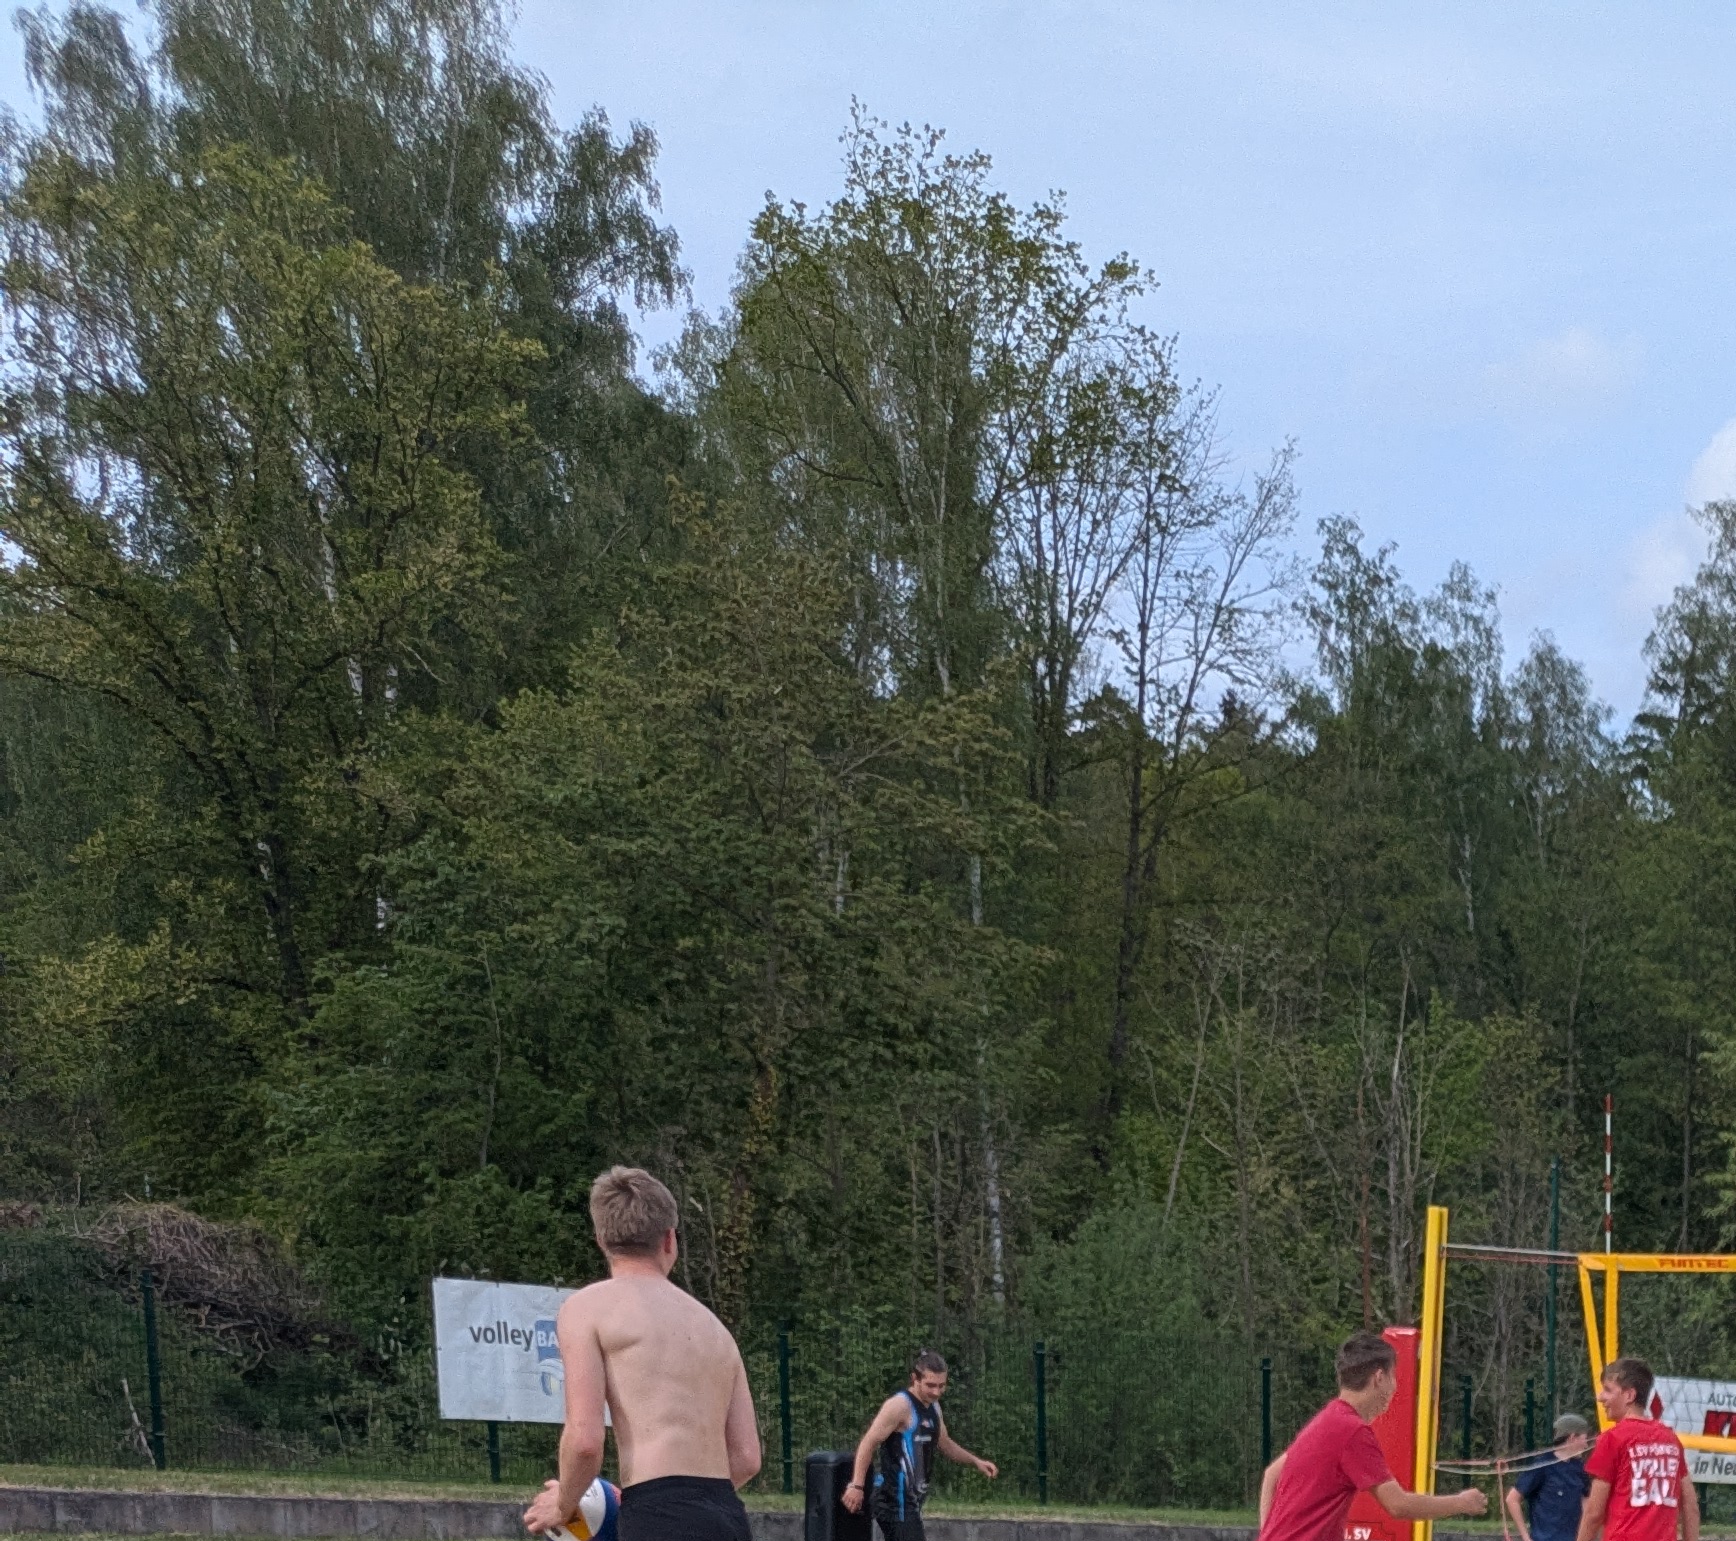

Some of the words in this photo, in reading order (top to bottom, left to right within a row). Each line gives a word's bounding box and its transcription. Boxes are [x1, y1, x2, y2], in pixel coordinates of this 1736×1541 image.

[469, 1320, 560, 1352] volleyBA
[1694, 1458, 1707, 1475] in
[1354, 1528, 1372, 1540] SV
